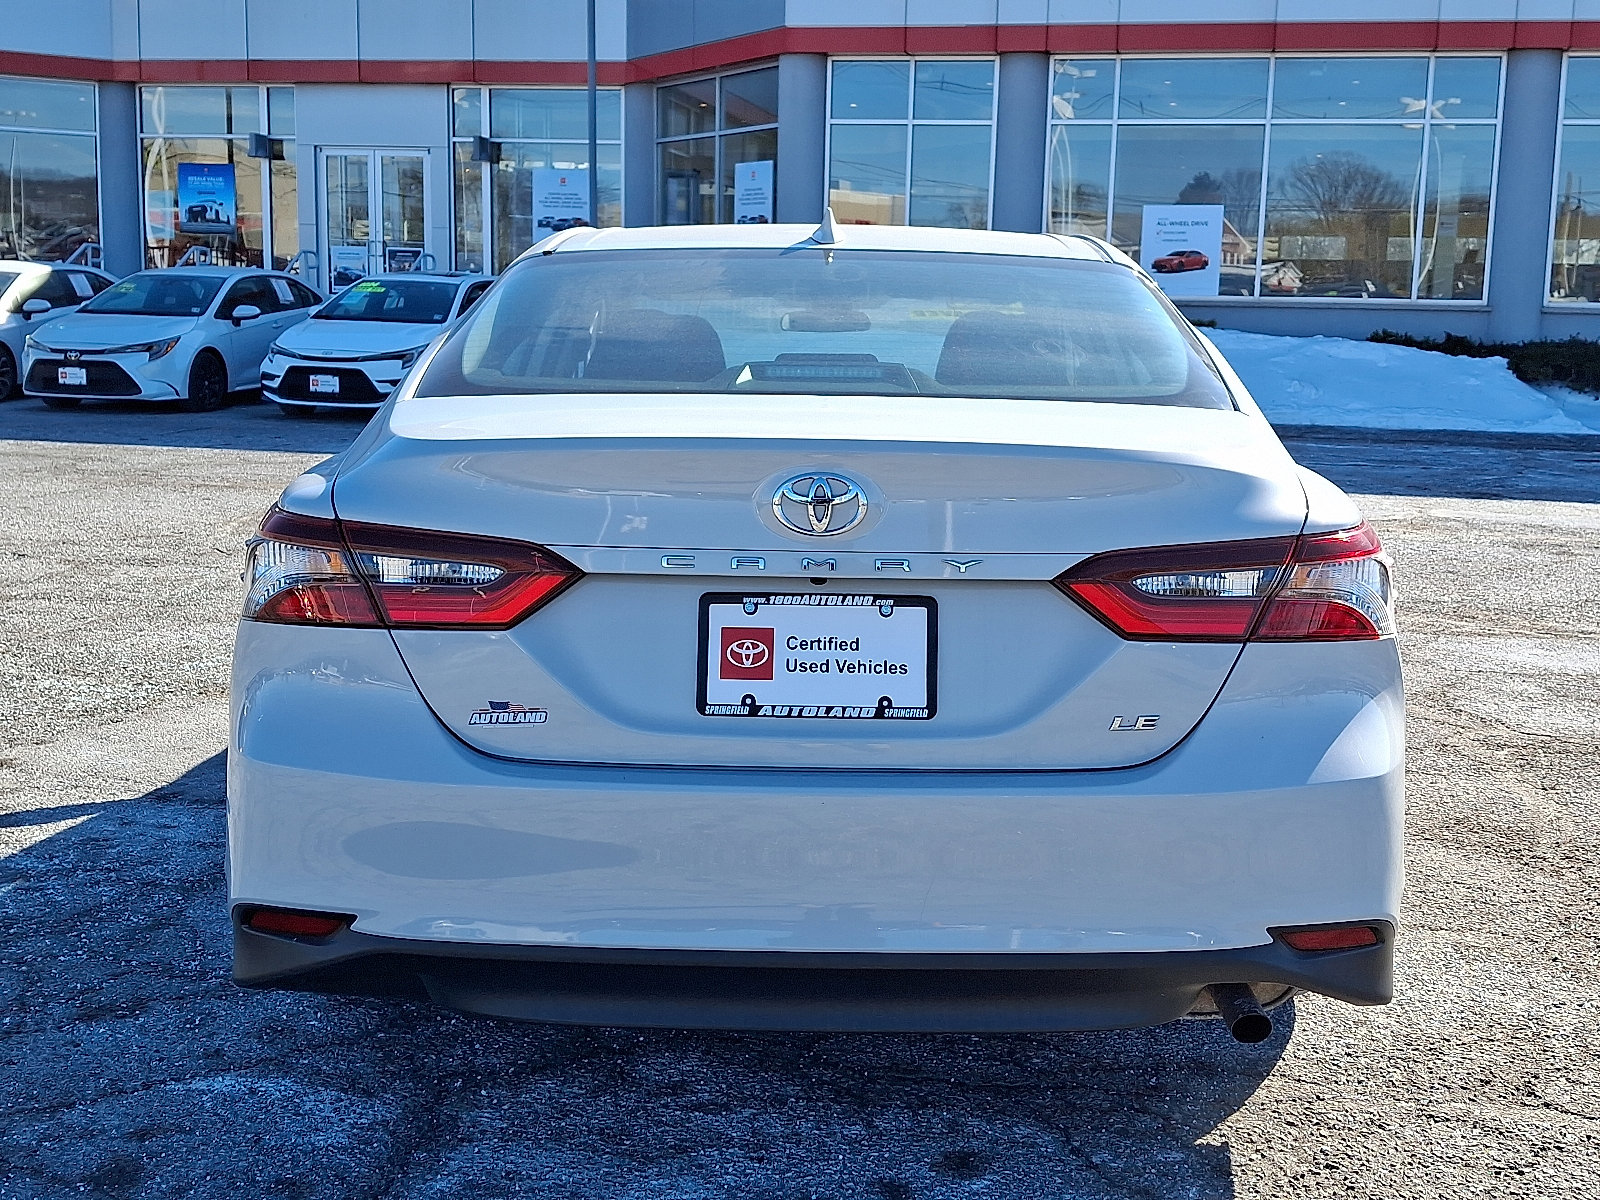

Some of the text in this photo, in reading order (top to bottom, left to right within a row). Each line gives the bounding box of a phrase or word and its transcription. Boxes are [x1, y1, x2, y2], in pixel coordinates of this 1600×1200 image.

[661, 555, 983, 572] CAMRY
[742, 595, 894, 607] www.1800AUTOLAND.com
[785, 636, 860, 652] Certified
[785, 658, 909, 675] Used Vehicles
[470, 712, 547, 724] AUTOLAND
[705, 705, 929, 718] SPRINGFIELD AUTOLAND SPRINGFIELD
[1109, 715, 1160, 731] LE
